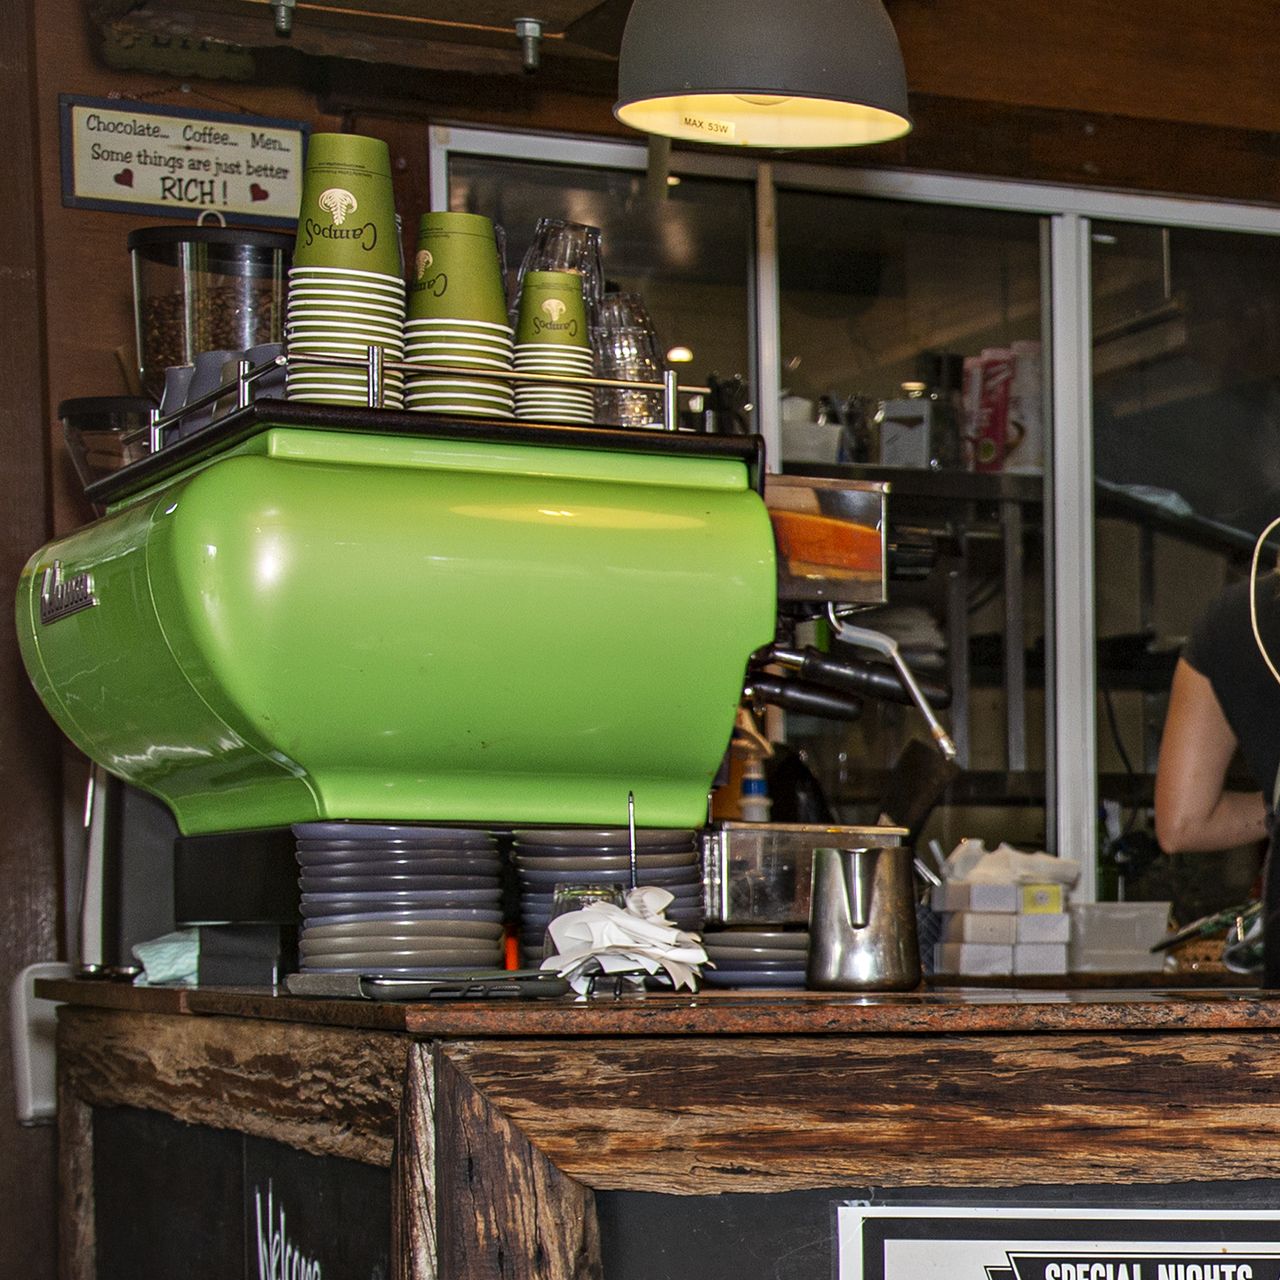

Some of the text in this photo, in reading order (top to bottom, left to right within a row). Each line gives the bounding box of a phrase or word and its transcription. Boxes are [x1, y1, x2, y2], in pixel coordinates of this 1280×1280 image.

[684, 117, 729, 134] MAX 53W
[91, 143, 132, 164] Some
[137, 151, 184, 174] things
[188, 157, 211, 172] are
[213, 157, 243, 177] just
[245, 161, 289, 180] better
